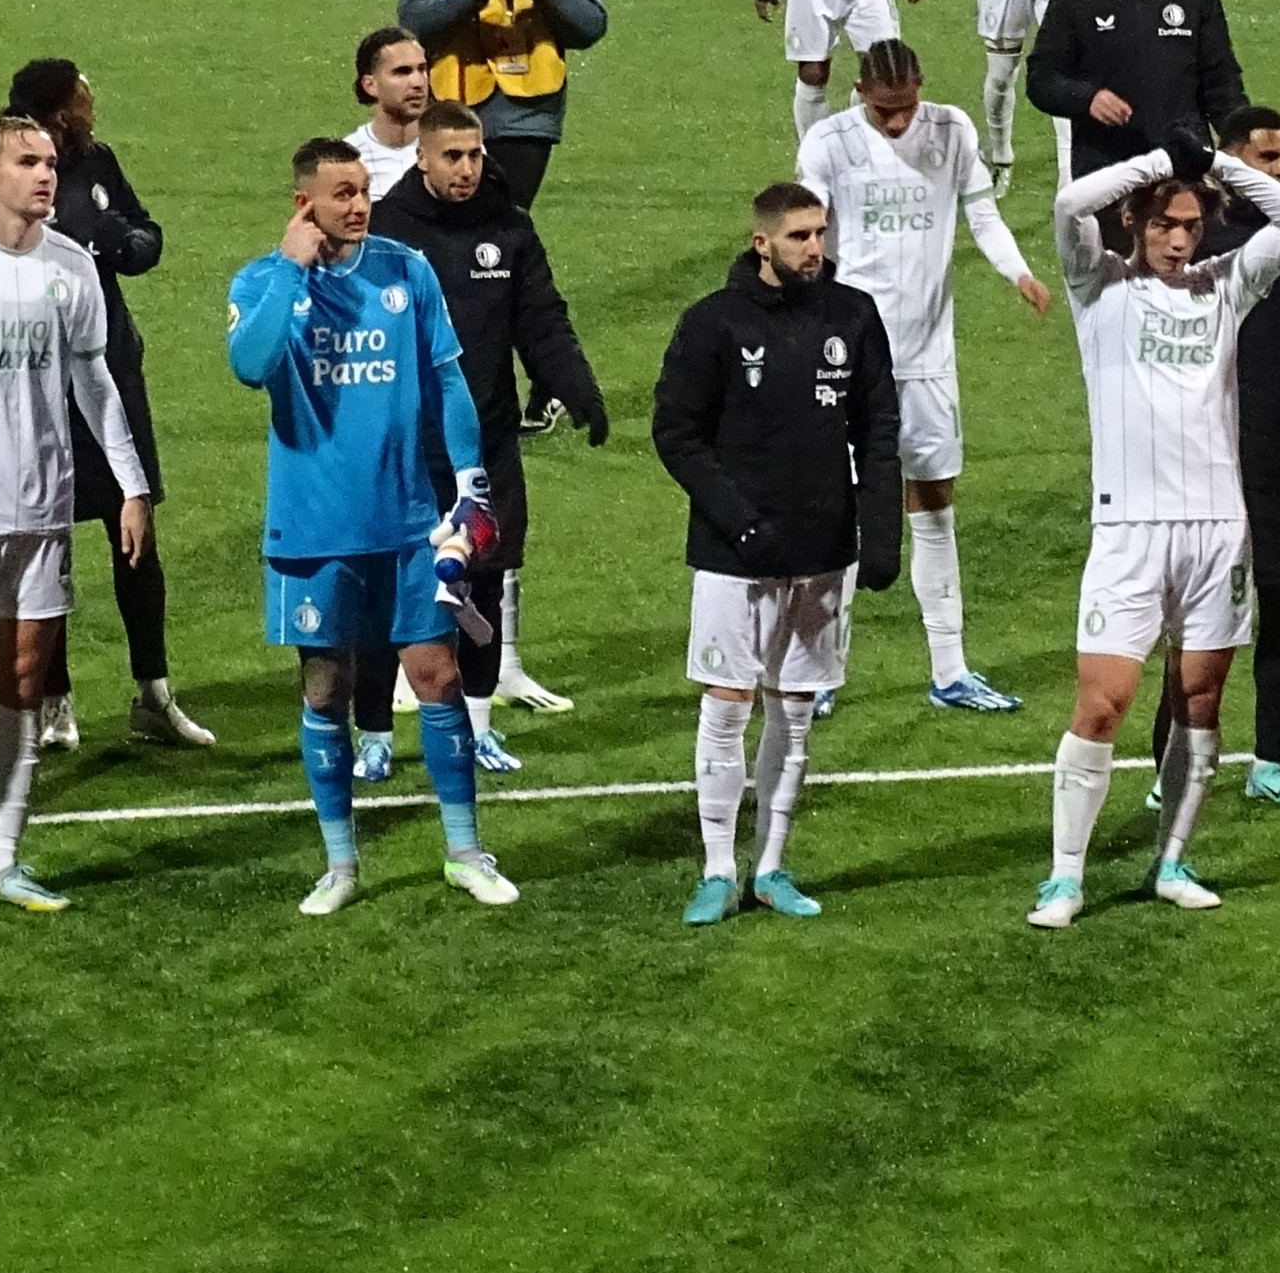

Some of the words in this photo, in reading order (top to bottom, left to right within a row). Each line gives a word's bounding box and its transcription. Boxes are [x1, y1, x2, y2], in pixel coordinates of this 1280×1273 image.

[864, 182, 927, 208] Euro
[862, 209, 935, 234] Parcs
[1141, 310, 1208, 338] Euro
[312, 327, 387, 355] Euro
[1137, 337, 1215, 365] Parcs
[312, 359, 397, 387] Parcs
